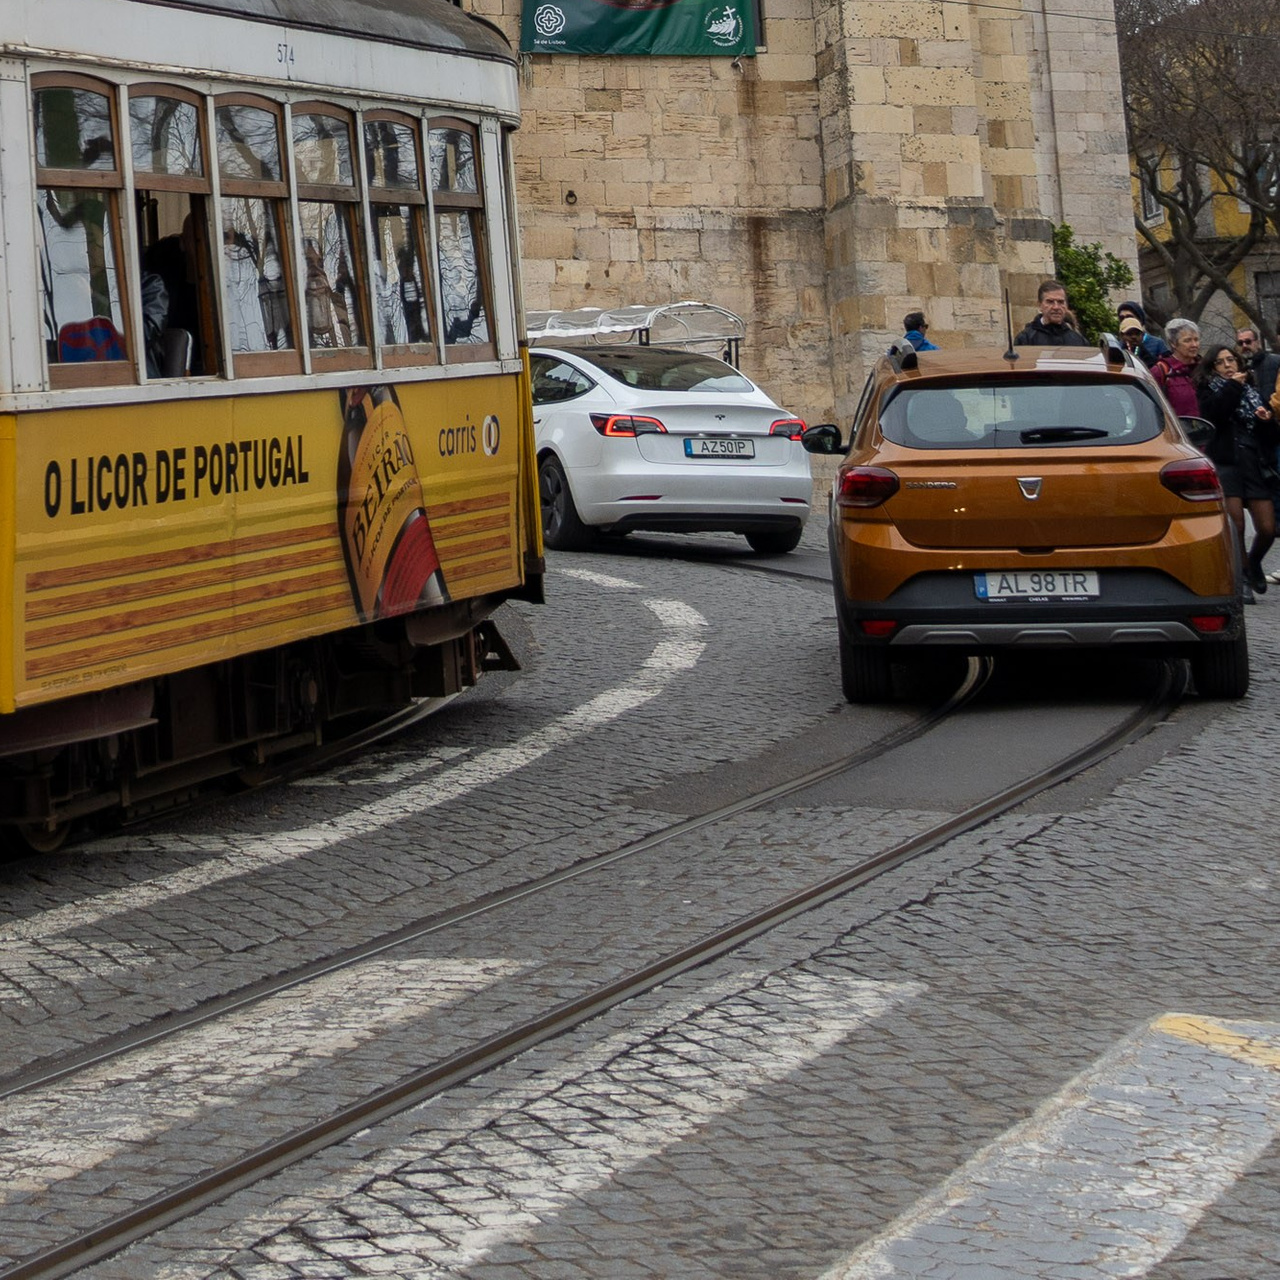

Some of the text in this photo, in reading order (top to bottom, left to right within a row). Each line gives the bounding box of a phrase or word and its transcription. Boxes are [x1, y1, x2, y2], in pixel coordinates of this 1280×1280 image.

[277, 43, 295, 65] 574
[439, 414, 476, 456] carris
[44, 460, 61, 518] O
[71, 451, 148, 515] LICOR
[156, 447, 186, 504] DE
[194, 435, 309, 498] PORTUGAL
[905, 481, 957, 489] SANDERO
